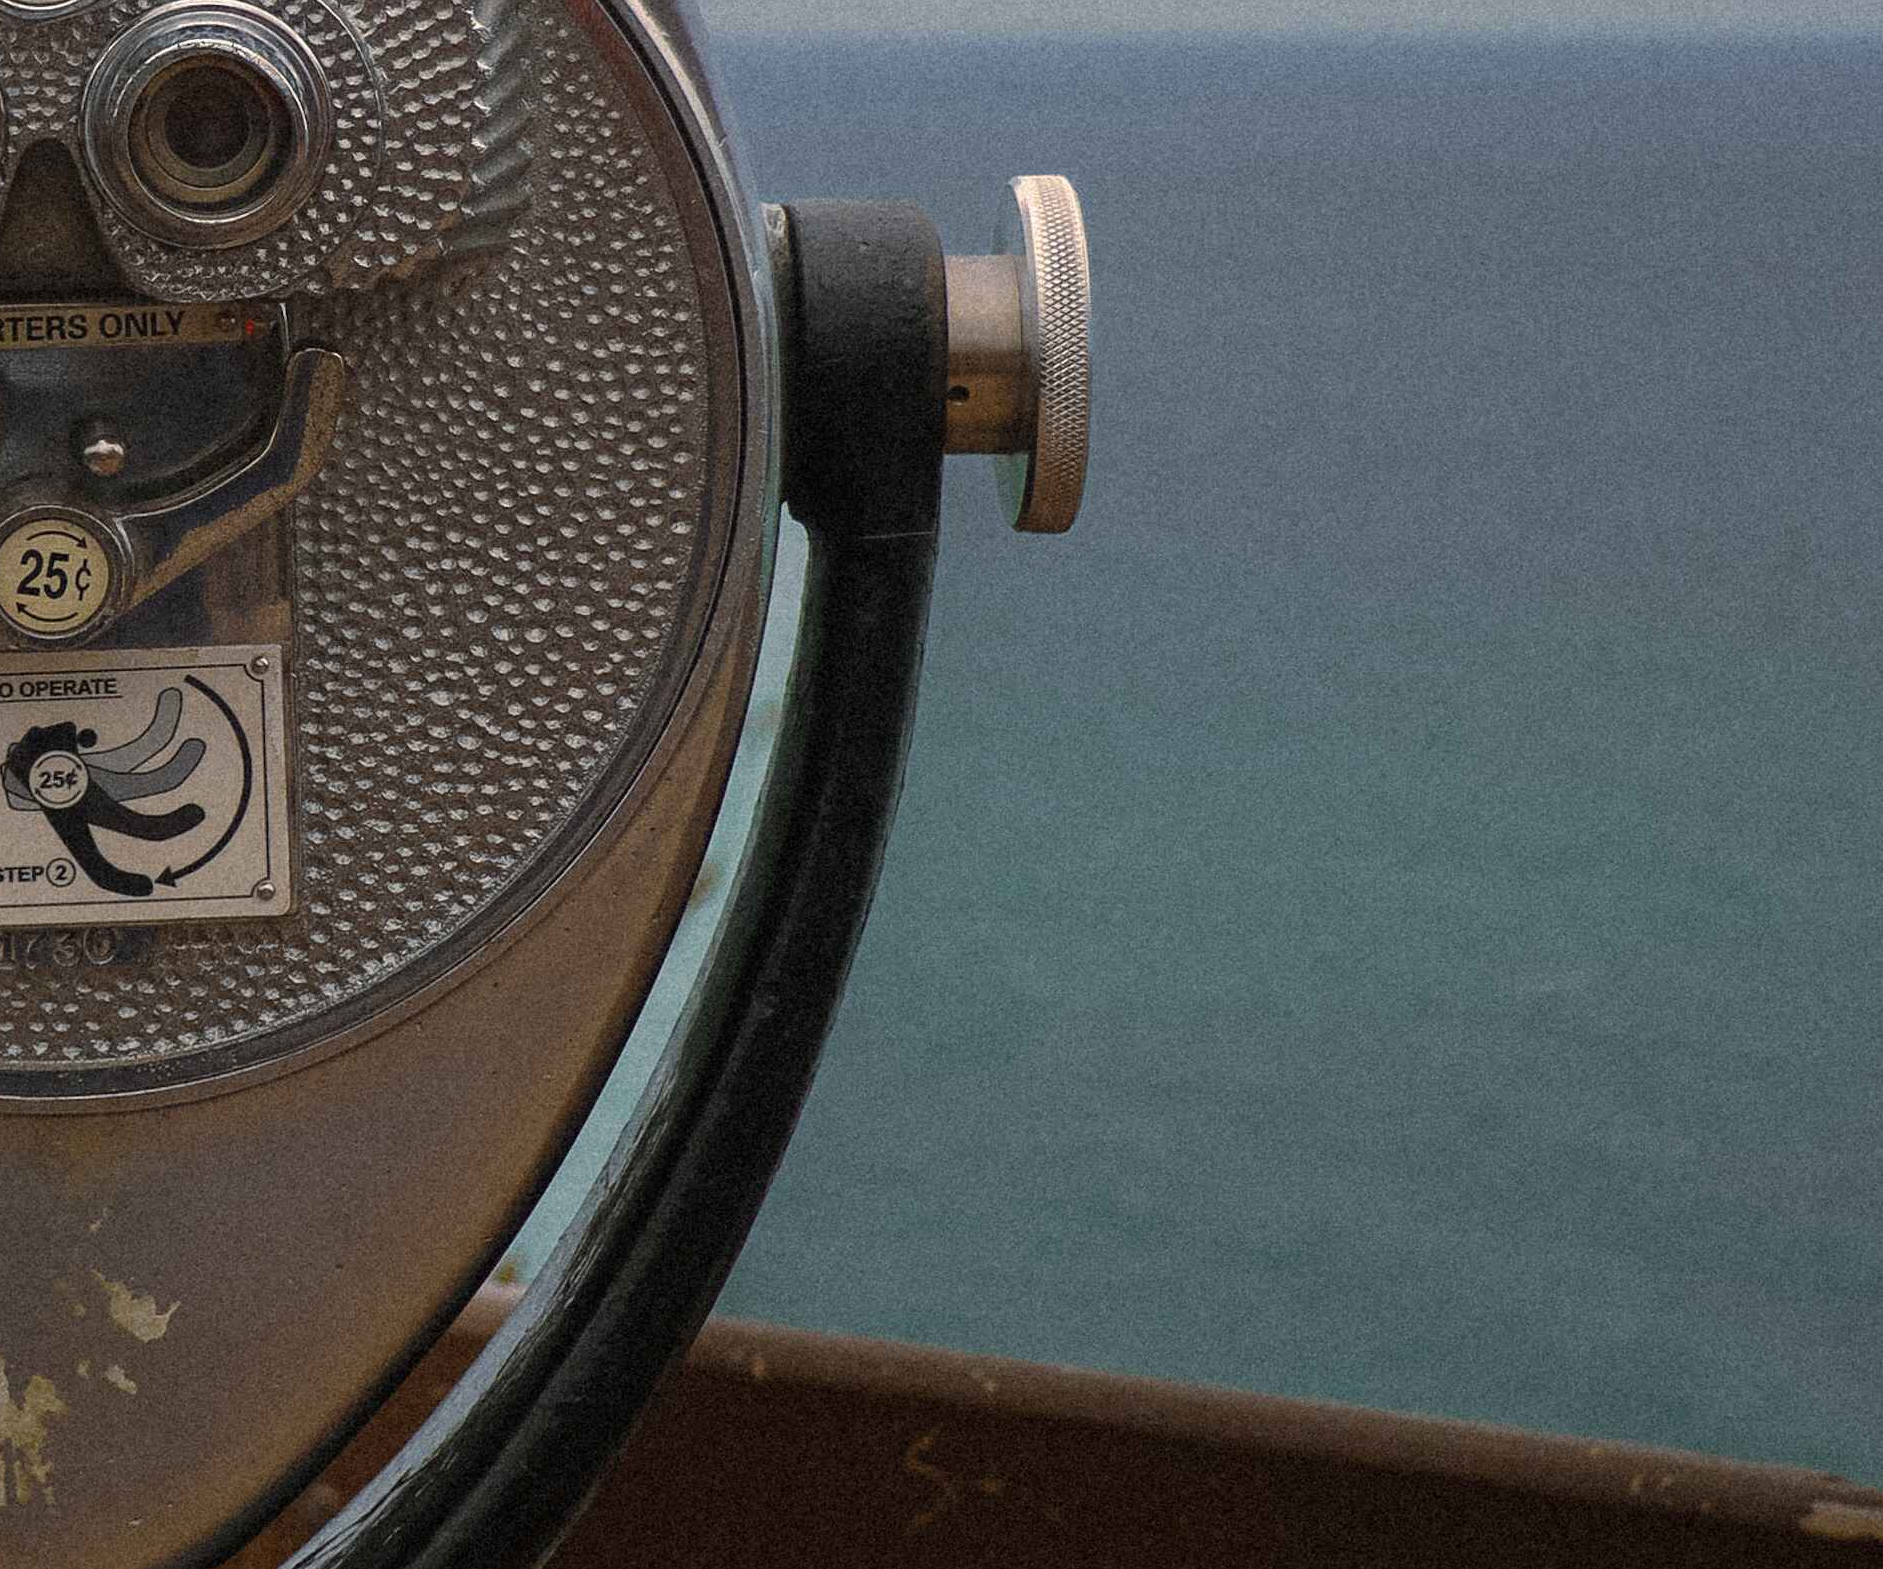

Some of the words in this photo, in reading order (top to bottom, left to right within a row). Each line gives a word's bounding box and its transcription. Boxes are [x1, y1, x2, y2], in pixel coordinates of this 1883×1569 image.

[99, 310, 186, 338] ONLY
[17, 548, 91, 601] 25¢
[19, 678, 117, 698] OPERATE
[39, 770, 78, 790] 25¢
